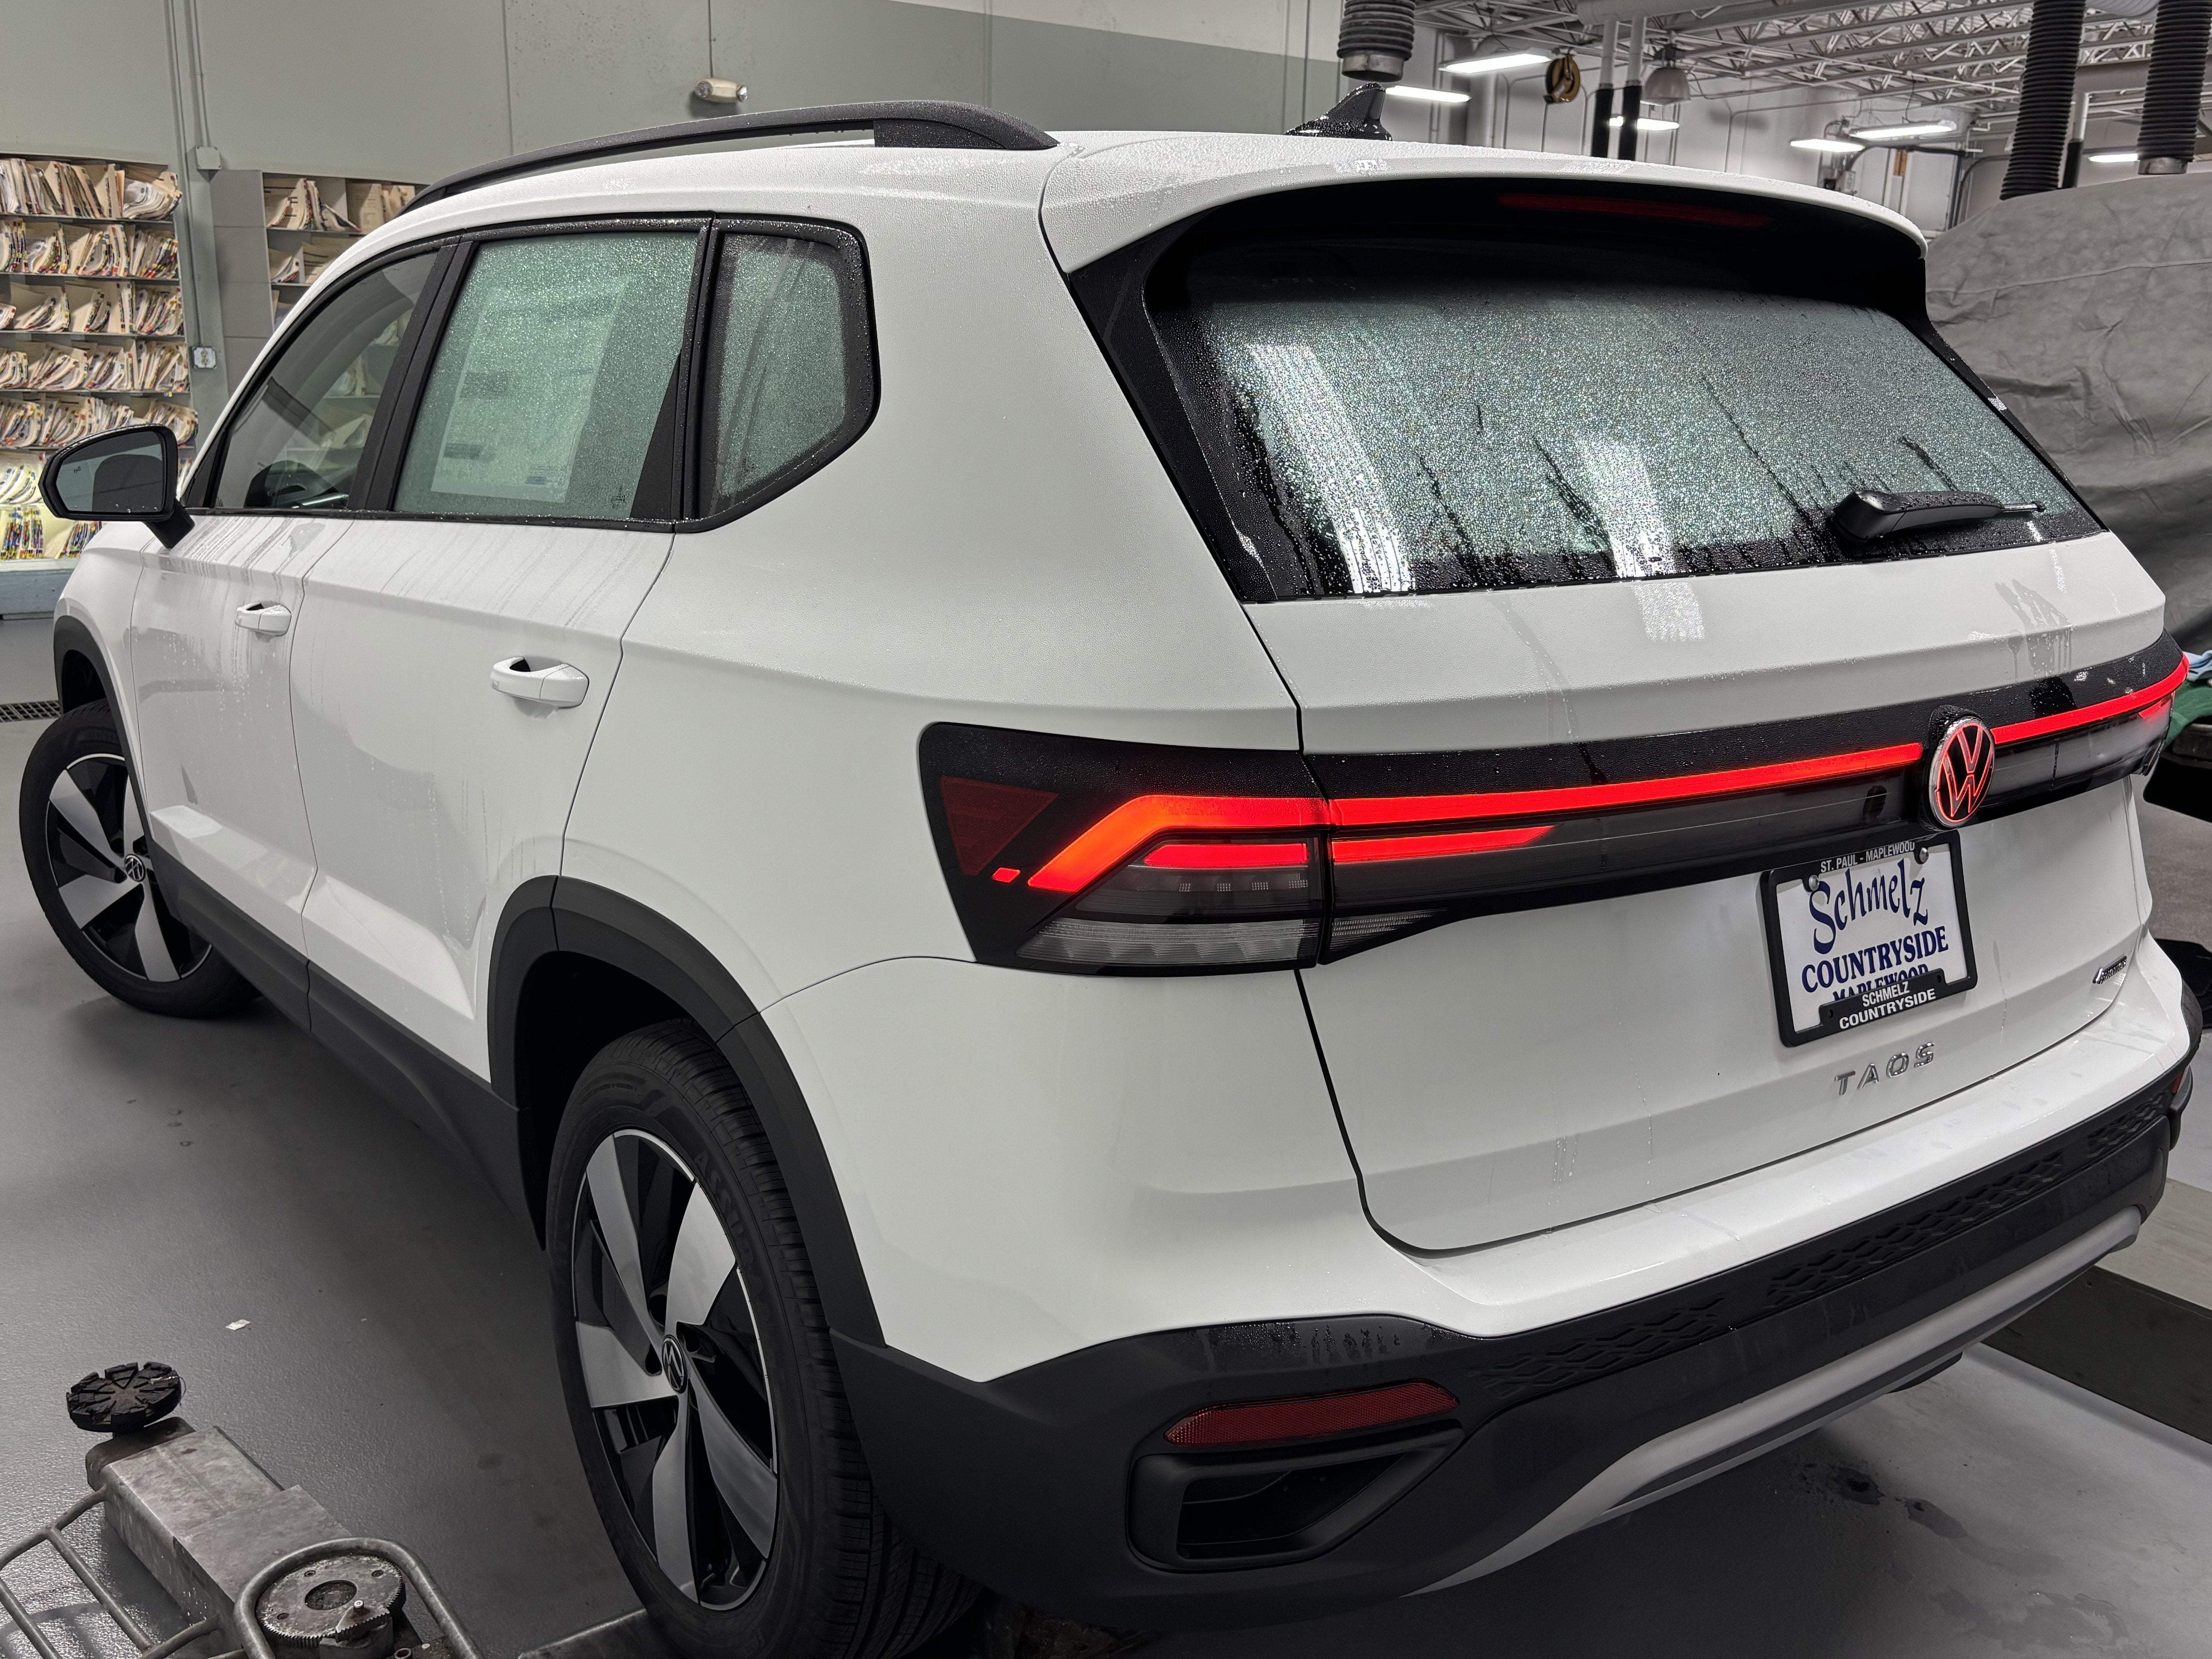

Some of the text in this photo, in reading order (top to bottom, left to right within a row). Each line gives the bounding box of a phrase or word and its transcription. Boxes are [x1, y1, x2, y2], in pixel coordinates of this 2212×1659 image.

[1820, 859, 1834, 873] ST.
[1836, 854, 1858, 869] PAUL
[1865, 841, 1915, 862] MAPLEWOOD
[1809, 858, 1928, 955] Schmelz
[1802, 926, 1949, 993] COUNTRYSIDE
[1839, 988, 1936, 1029] COUNTRYSIDE
[1862, 981, 1910, 1007] SCHMELZ
[1834, 1042, 1935, 1096] TAOS
